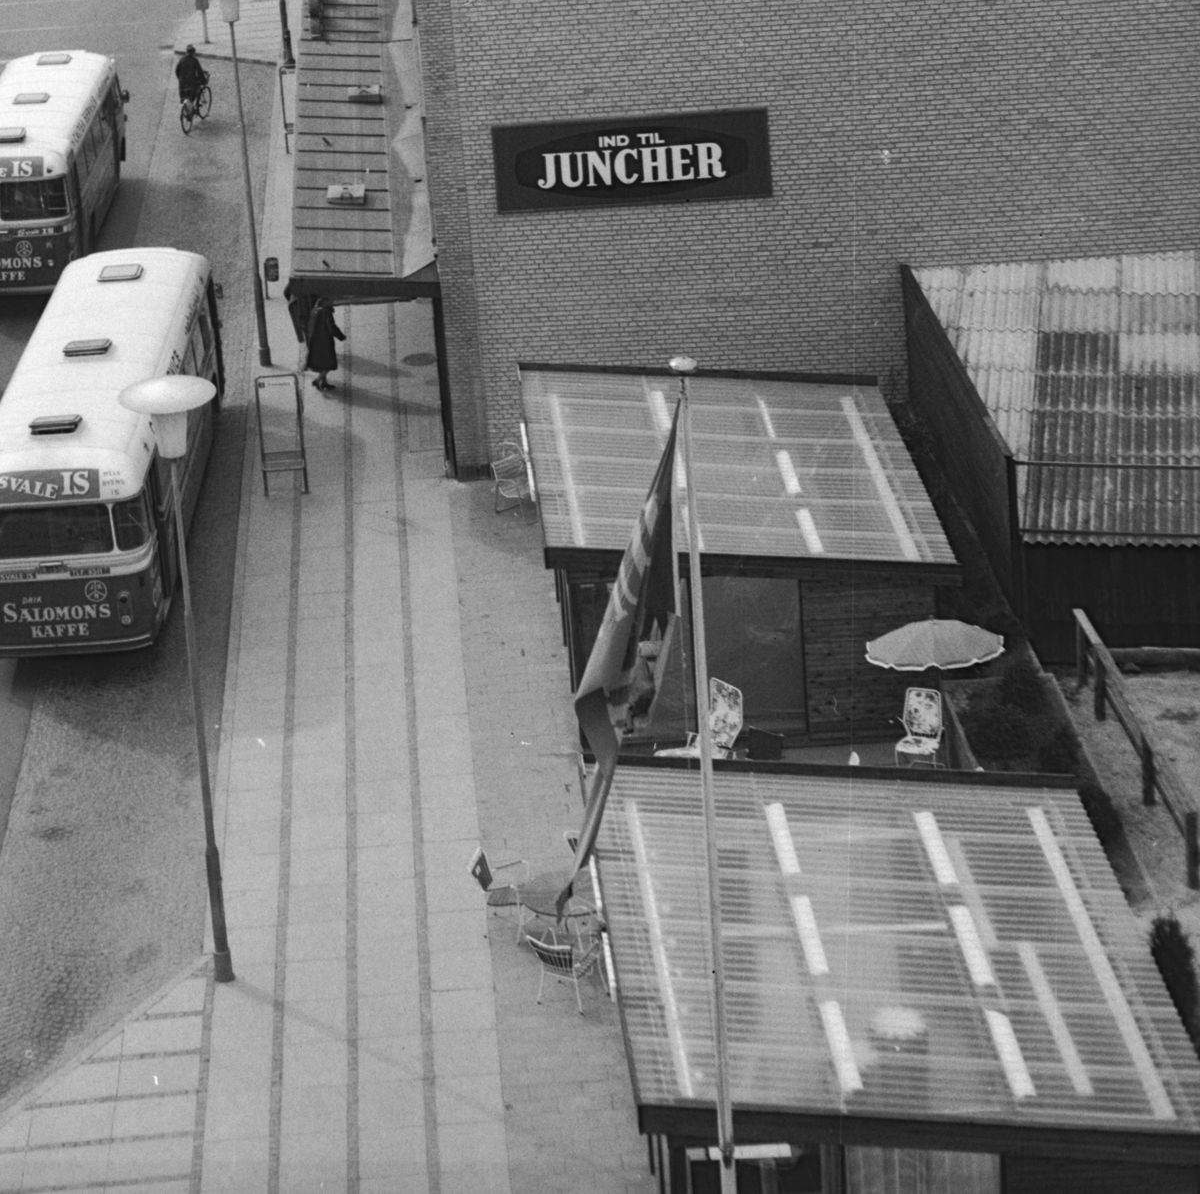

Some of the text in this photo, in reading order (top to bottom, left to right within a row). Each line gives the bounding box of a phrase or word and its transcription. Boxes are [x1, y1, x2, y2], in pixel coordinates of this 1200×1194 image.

[598, 133, 665, 148] IND TIL
[11, 160, 34, 177] IS
[537, 142, 727, 189] JUNCHER
[60, 470, 90, 496] IS
[22, 596, 43, 605] DRIK
[3, 602, 111, 624] SALOMONS
[31, 622, 90, 638] KAFFE
